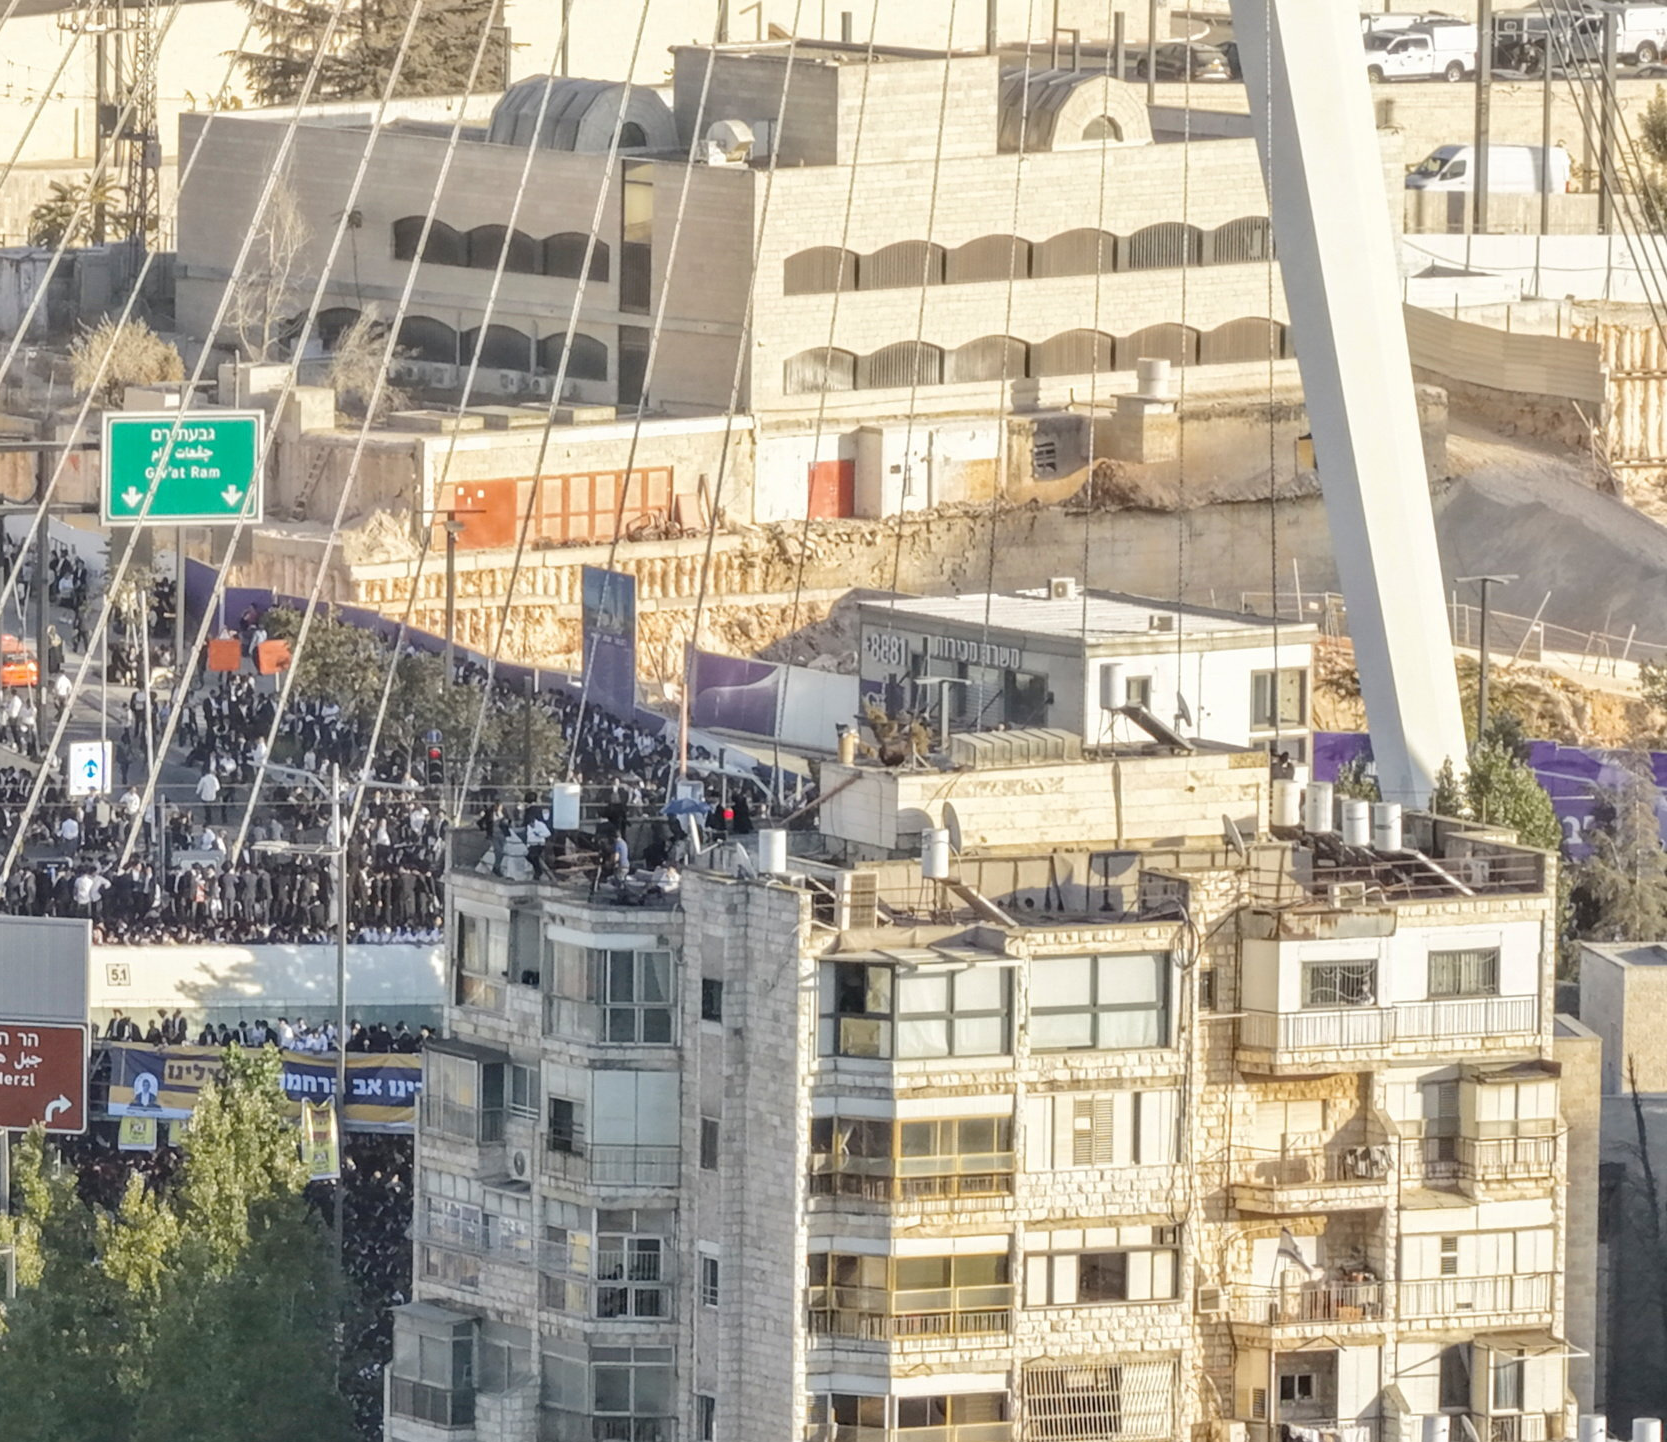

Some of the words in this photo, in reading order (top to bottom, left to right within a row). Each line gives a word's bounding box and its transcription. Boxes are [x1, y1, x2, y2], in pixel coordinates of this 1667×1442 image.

[151, 429, 171, 442] רם
[191, 466, 221, 479] Ram
[934, 636, 978, 663] מכירות
[110, 967, 127, 982] 5.1
[17, 1033, 40, 1047] הר
[13, 1052, 43, 1070] جبل
[352, 1077, 382, 1096] אב
